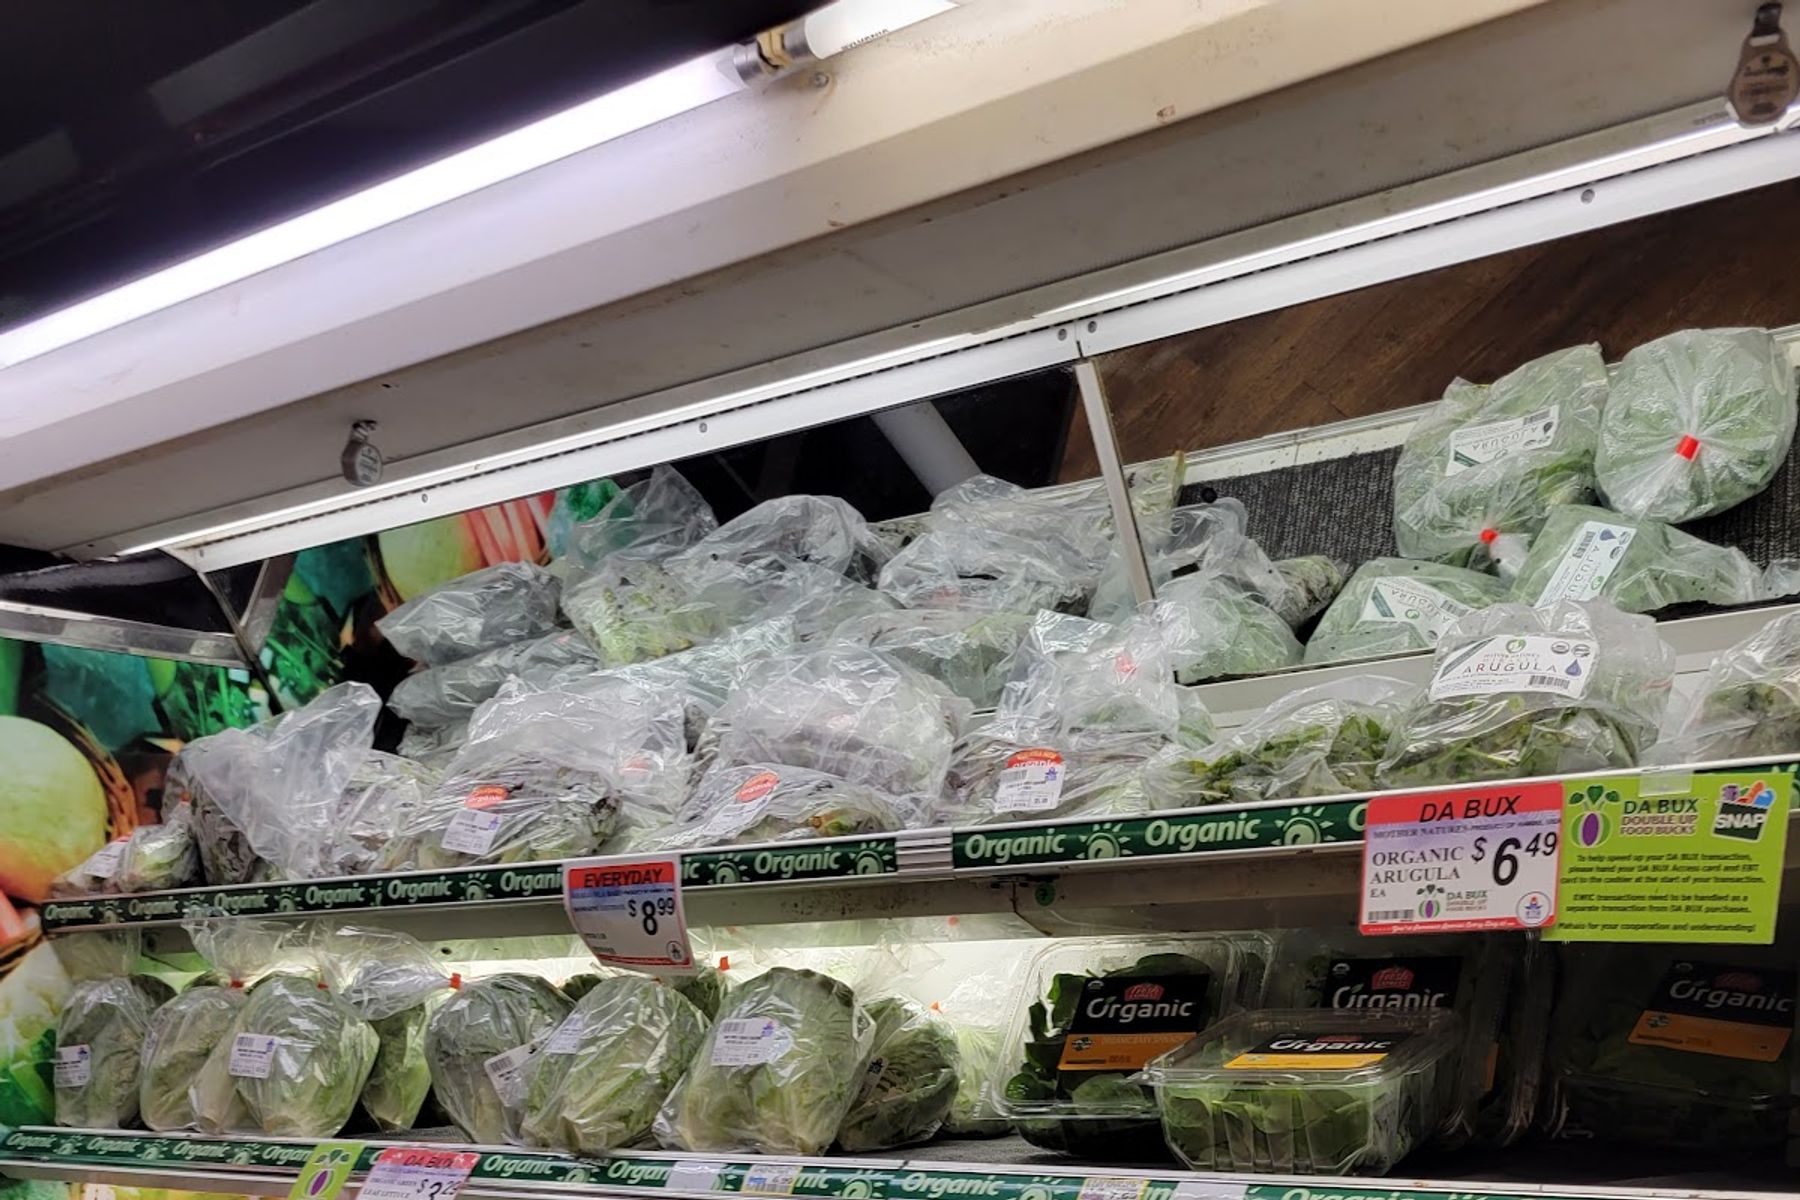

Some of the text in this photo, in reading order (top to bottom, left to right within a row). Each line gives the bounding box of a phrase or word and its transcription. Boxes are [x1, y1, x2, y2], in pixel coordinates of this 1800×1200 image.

[1462, 662, 1558, 674] ARUGULA
[1419, 795, 1522, 823] DA BUX
[1624, 798, 1699, 815] DA BUX
[1620, 825, 1697, 835] FOOD BUCKS
[1622, 814, 1698, 826] DOUBLE UP
[1714, 813, 1767, 830] SNAP
[1145, 812, 1262, 852] Organic
[964, 828, 1067, 864] Organic
[1372, 846, 1465, 867] ORGANIC
[753, 845, 841, 876] Organic
[500, 868, 562, 897] Organi
[584, 868, 662, 888] EVERYDAY
[1370, 867, 1461, 885] ARUGULA
[304, 884, 367, 909] Organic
[386, 876, 453, 902] Organic
[44, 902, 94, 921] Organic
[213, 893, 270, 917] Organic
[1668, 977, 1794, 1013] Organic
[1085, 997, 1197, 1024] Organic
[1269, 1039, 1392, 1052] Organic
[7, 1132, 54, 1150] Organic
[86, 1136, 142, 1157] Organic
[173, 1141, 230, 1161] Organic
[262, 1146, 311, 1167] Organ
[483, 1154, 555, 1180] Organic
[607, 1160, 671, 1184] Organ
[901, 1171, 1005, 1198] Organic
